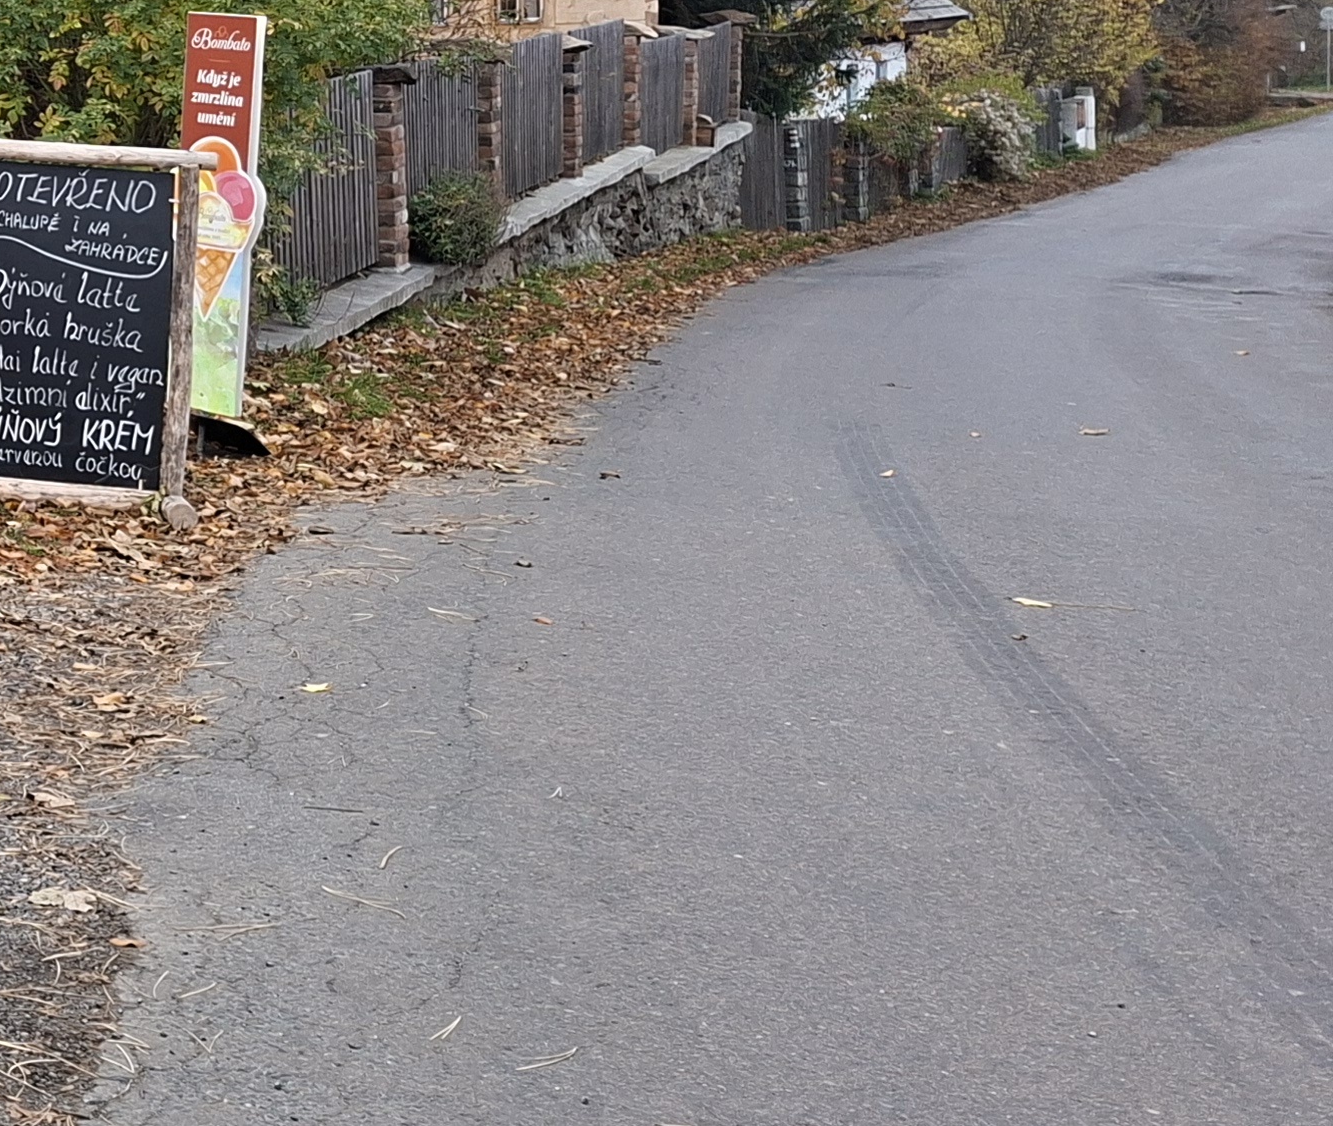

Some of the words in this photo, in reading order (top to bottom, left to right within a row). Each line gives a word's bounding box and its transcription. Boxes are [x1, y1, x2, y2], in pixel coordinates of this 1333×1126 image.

[196, 69, 229, 88] Když
[228, 72, 242, 88] je
[190, 91, 244, 108] zmrzlina
[196, 111, 236, 127] umění
[87, 221, 111, 237] NA
[64, 232, 161, 266] ZAHRÁDCE
[77, 271, 141, 312] latte
[63, 311, 144, 353] hruška
[32, 345, 79, 377] latte
[90, 354, 101, 380] i
[107, 363, 165, 394] vegan
[82, 409, 155, 456] KRÉM
[75, 451, 143, 481] čočkou
